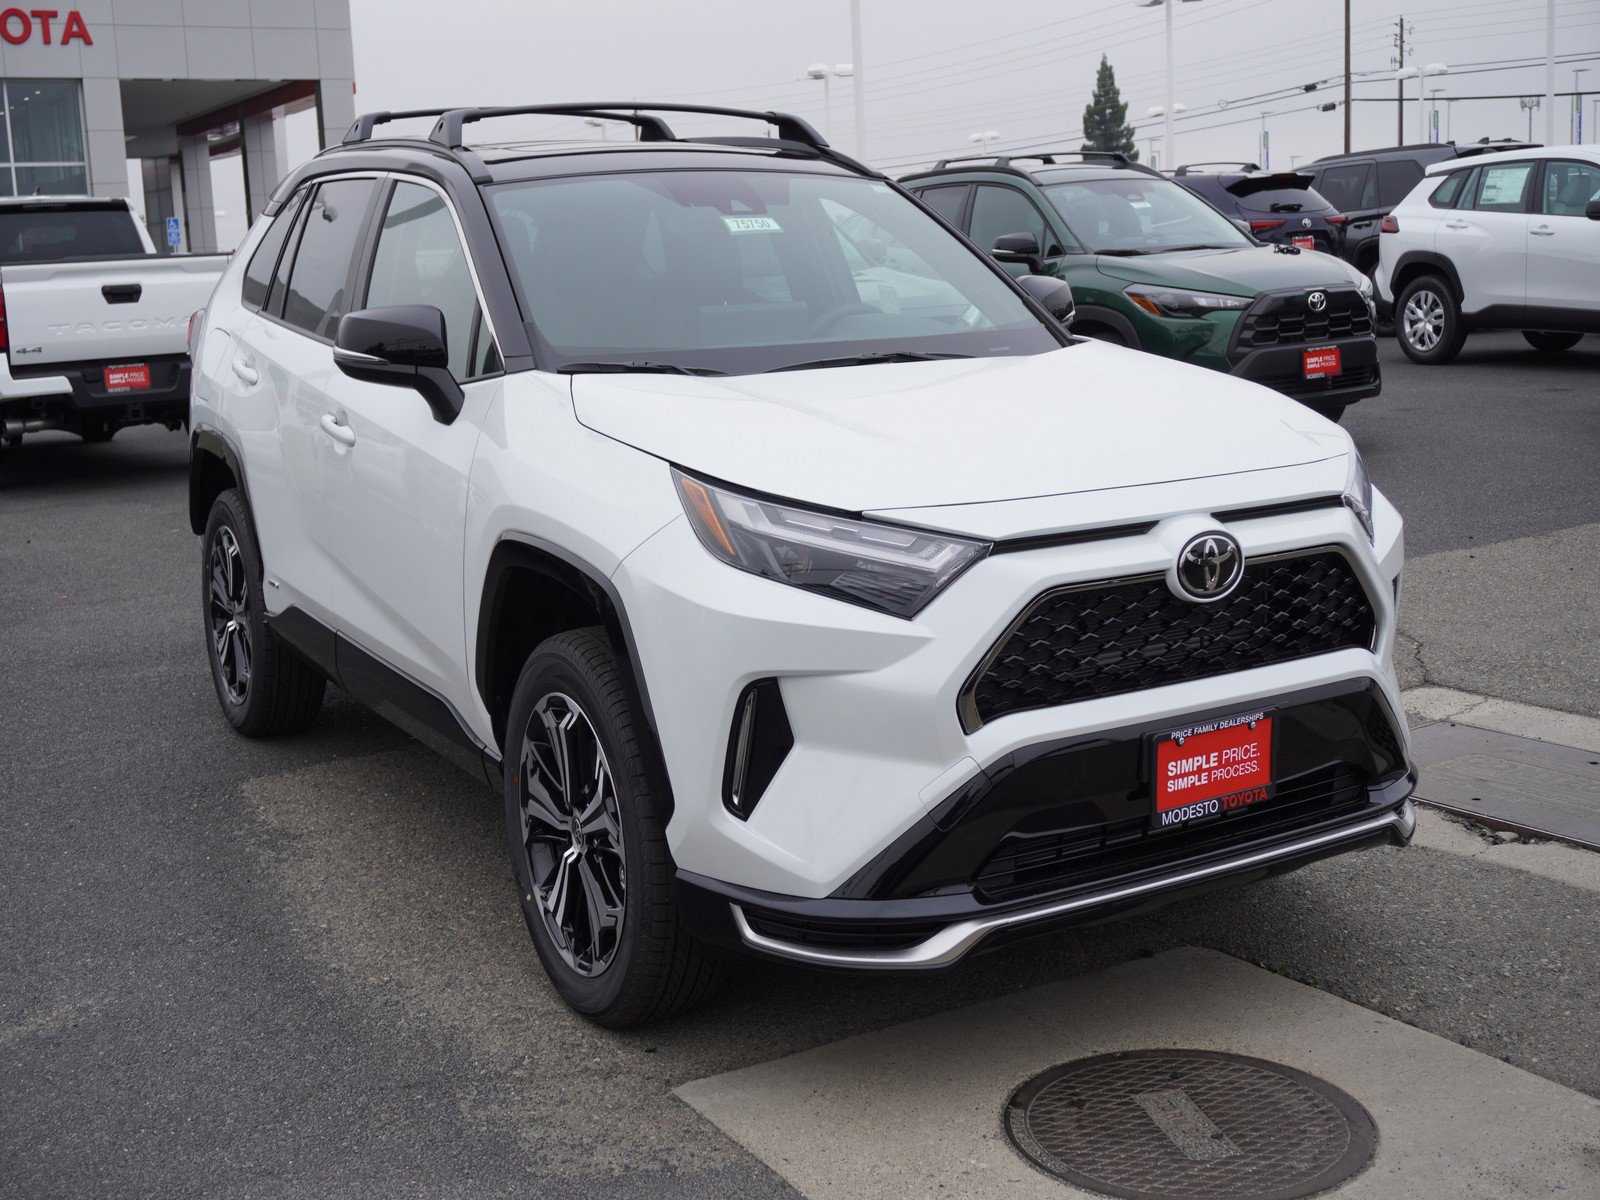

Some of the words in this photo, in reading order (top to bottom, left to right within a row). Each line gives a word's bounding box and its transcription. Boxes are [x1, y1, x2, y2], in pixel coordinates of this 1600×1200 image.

[0, 8, 93, 45] OTA
[732, 219, 771, 229] 75750
[1171, 729, 1192, 740] PRICE
[1194, 723, 1218, 735] FAMILY
[1219, 712, 1264, 730] DEALERSHIPS
[1167, 752, 1219, 777] SIMPLE
[1167, 772, 1208, 793] SIMPLE
[1162, 800, 1219, 826] MODESTO
[1221, 787, 1268, 810] TOYOTA
